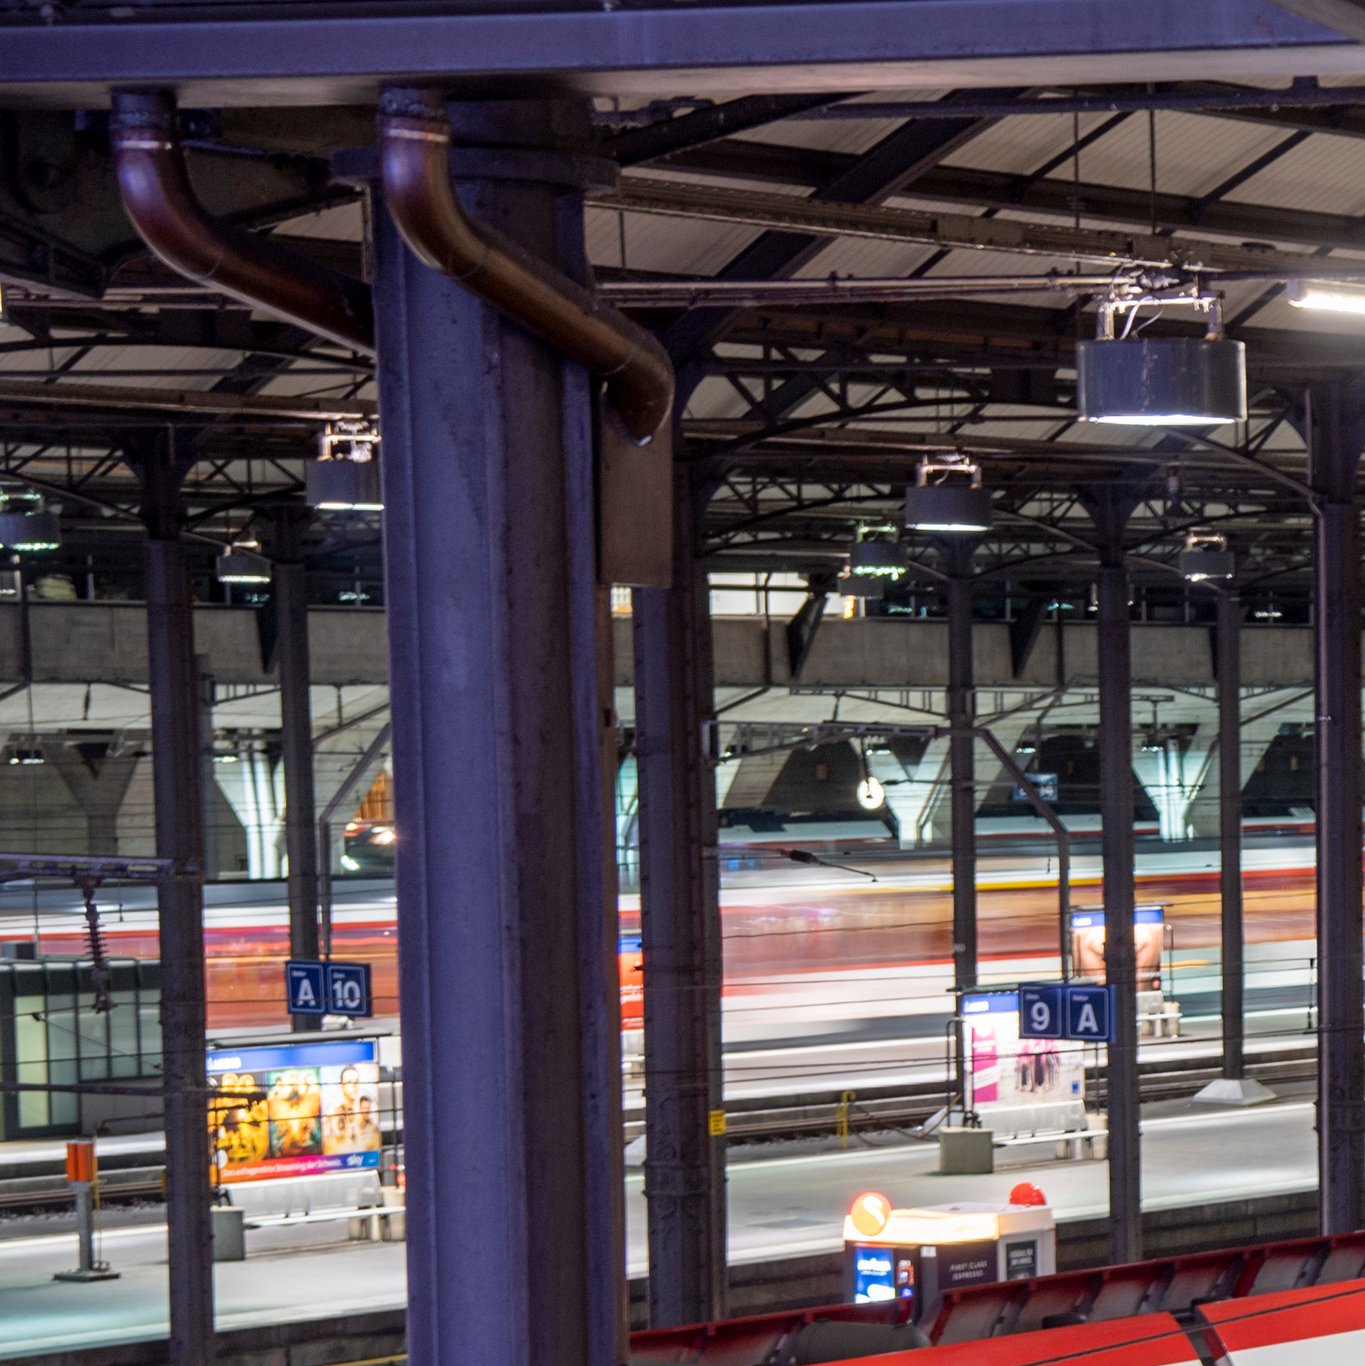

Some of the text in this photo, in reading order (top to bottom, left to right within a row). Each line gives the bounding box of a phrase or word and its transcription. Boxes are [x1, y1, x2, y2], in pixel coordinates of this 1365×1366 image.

[296, 979, 361, 1008] A 10
[1030, 1002, 1098, 1033] 9 A
